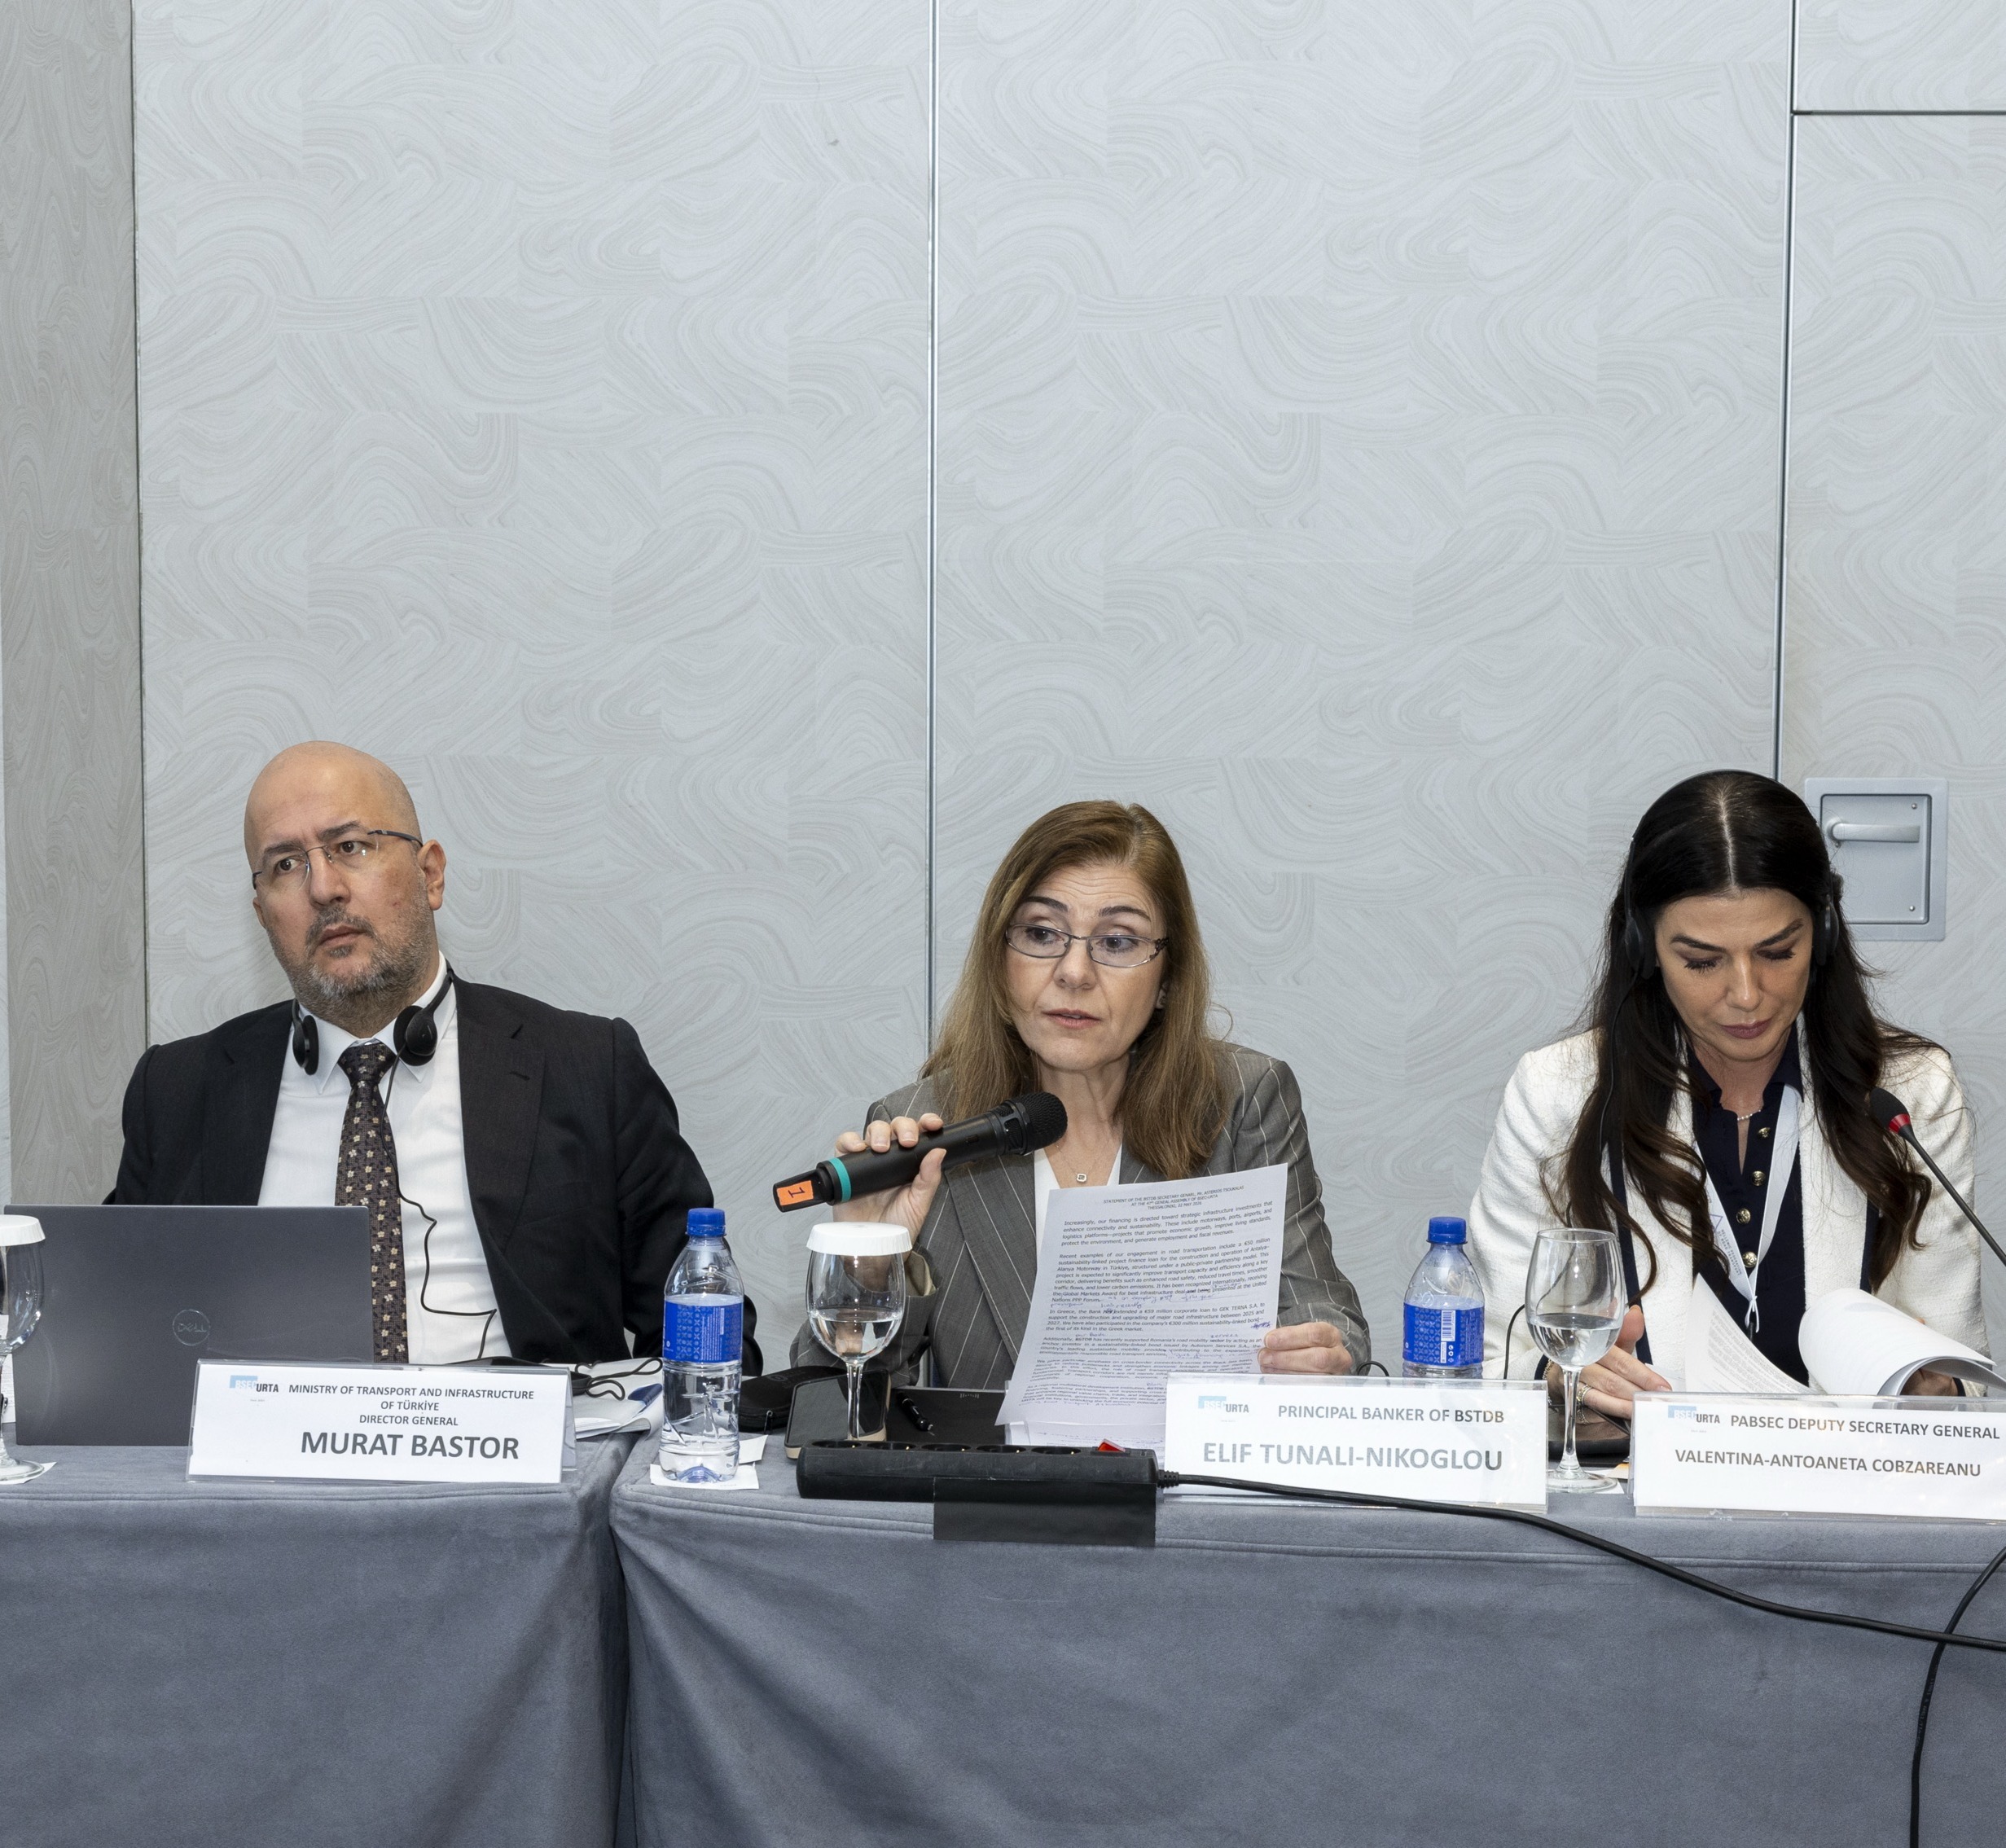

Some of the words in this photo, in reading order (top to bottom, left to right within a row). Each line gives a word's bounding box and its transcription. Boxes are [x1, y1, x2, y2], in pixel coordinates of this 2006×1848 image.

[788, 1187, 805, 1199] 1
[178, 1322, 207, 1332] DELL
[254, 1384, 279, 1392] URTA
[289, 1385, 338, 1394] MINISTRY
[340, 1386, 353, 1394] OF
[357, 1386, 417, 1396] TRANSPORT
[419, 1388, 442, 1397] AND
[446, 1389, 534, 1399] INFRASTRUCTURE
[381, 1401, 394, 1409] OF
[397, 1400, 439, 1411] TÜRKİYE
[1226, 1404, 1249, 1412] URTA
[360, 1415, 409, 1424] DIRECTOR
[412, 1416, 458, 1425] GENERAL
[1279, 1406, 1357, 1419] PRINCIPAL
[1363, 1407, 1424, 1420] BANKER
[1429, 1409, 1450, 1421] OF
[1455, 1410, 1503, 1423] BSTDB
[1696, 1414, 1720, 1424] URTA
[1732, 1416, 1784, 1429] PABSEC
[1789, 1418, 1845, 1431] DEPUTY
[1850, 1420, 1929, 1435] SECRETARY
[1933, 1425, 1999, 1439] GENERAL
[301, 1432, 403, 1455] MURAT
[411, 1435, 519, 1460] BASTOR
[1205, 1443, 1251, 1463] ELIF
[1260, 1445, 1502, 1471] TUNALI-NIKOGLOU
[1675, 1450, 1868, 1471] VALENTINA-ANTOANETA
[1872, 1460, 1980, 1477] COBZAREANU
